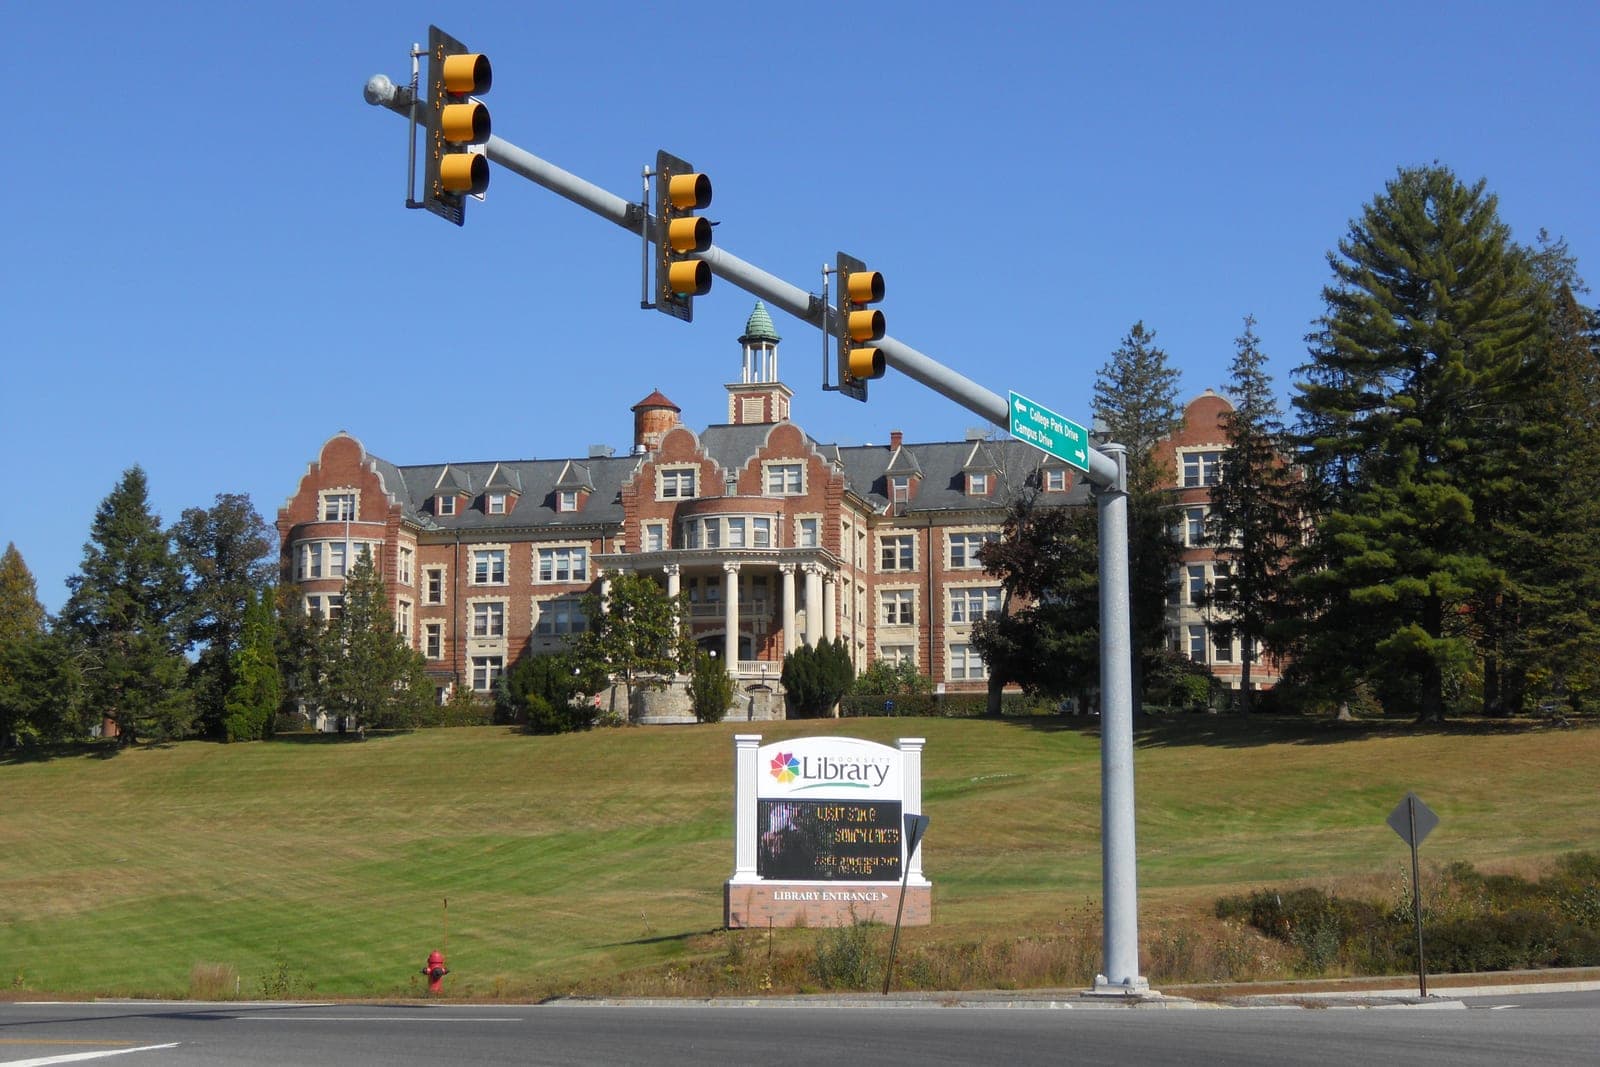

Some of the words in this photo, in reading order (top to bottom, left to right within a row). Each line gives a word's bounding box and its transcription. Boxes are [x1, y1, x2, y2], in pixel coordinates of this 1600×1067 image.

[1014, 419, 1038, 440] Campus
[1038, 430, 1053, 448] Drive
[1029, 407, 1049, 429] College
[1050, 417, 1063, 435] Park
[1064, 424, 1079, 442] Drive
[803, 756, 890, 787] Library
[774, 891, 820, 900] LIBRARY
[822, 891, 879, 901] ENTRANCE
